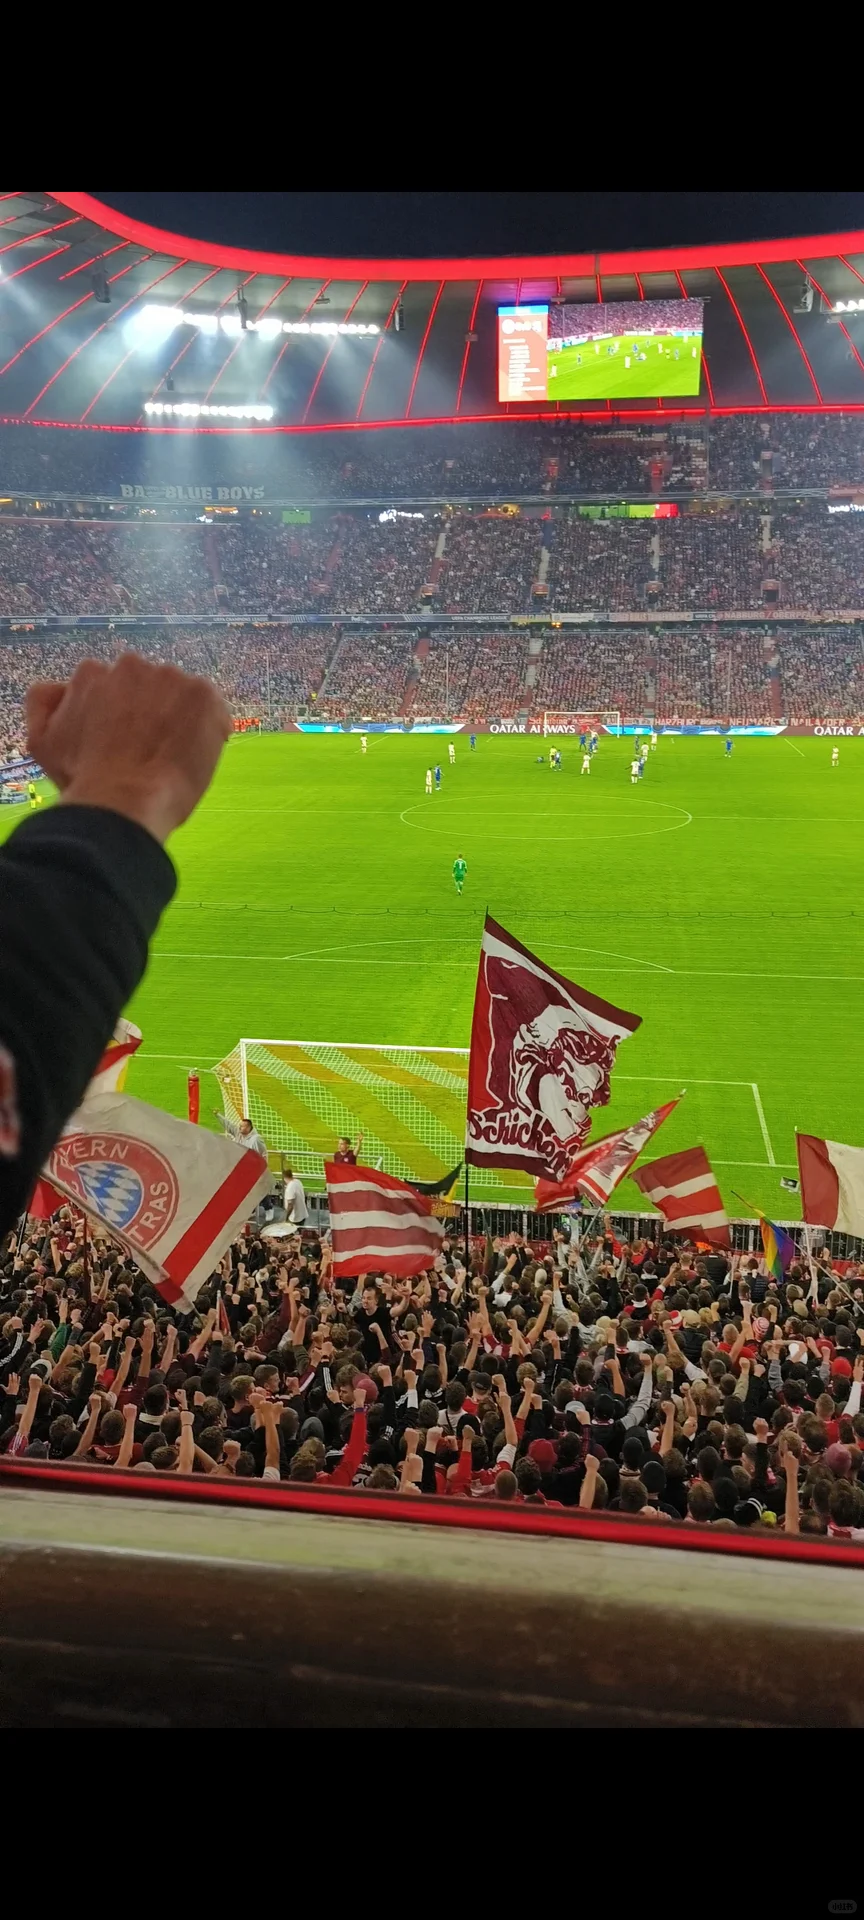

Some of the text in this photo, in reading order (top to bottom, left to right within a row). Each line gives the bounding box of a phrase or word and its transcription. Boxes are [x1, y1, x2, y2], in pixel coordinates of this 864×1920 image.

[165, 485, 213, 500] BLUE
[217, 485, 265, 500] BOYS
[490, 724, 526, 734] QATAR
[813, 726, 854, 736] QATAR
[126, 1180, 169, 1243] TRAS
